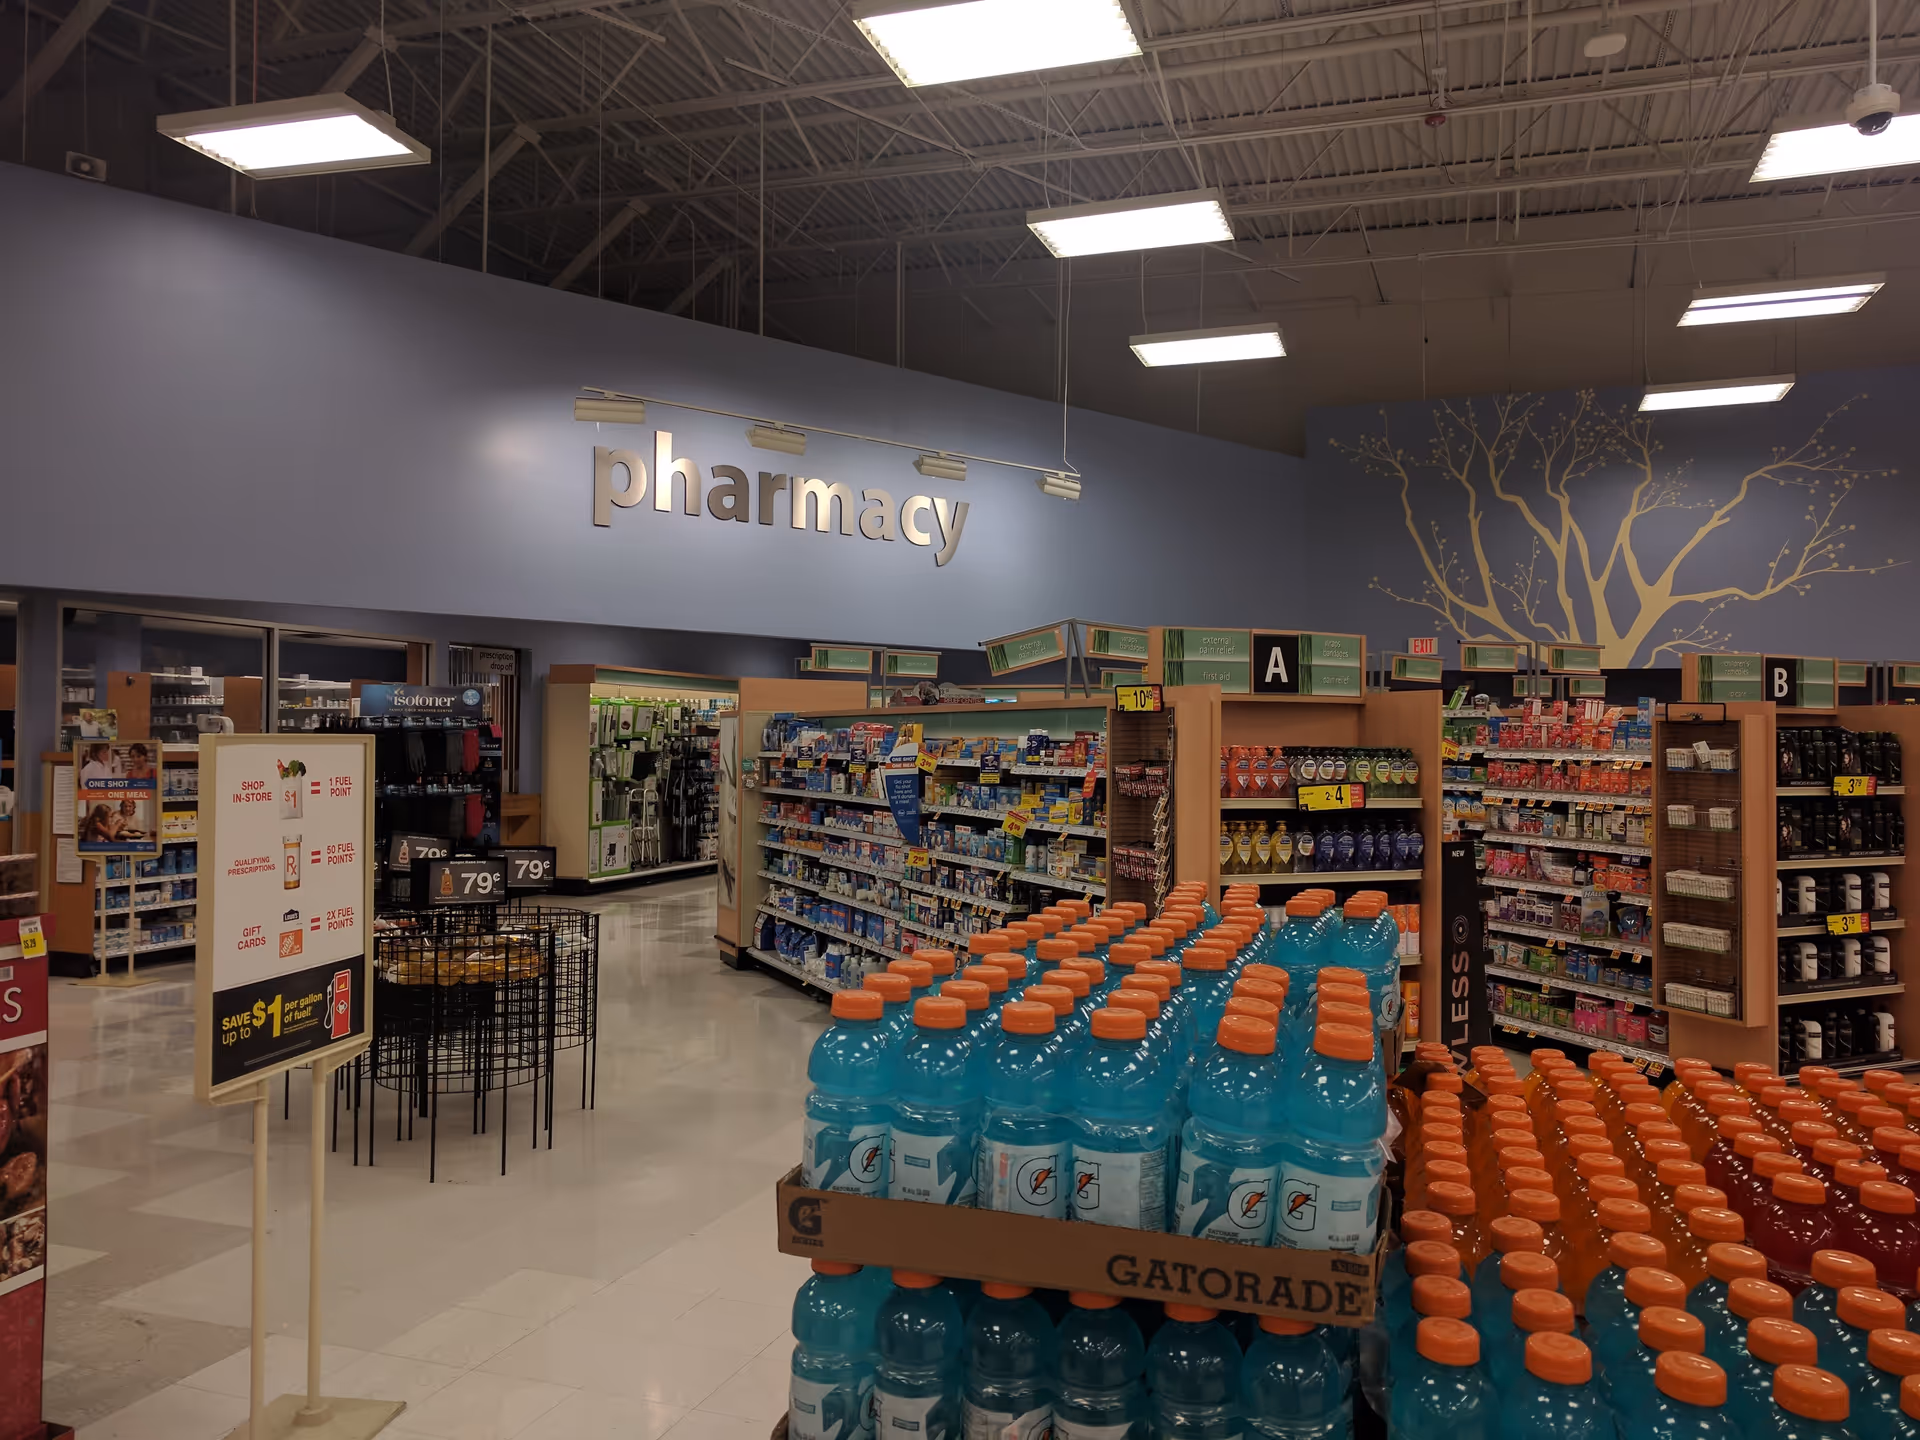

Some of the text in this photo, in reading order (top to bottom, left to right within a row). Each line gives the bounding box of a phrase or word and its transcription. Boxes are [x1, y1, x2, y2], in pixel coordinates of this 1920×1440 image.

[594, 431, 970, 567] pharmacy
[1202, 636, 1232, 645] external
[1413, 638, 1433, 653] EXIT
[479, 651, 514, 661] prescription
[1199, 645, 1235, 656] pain relief
[490, 662, 514, 672] drop off
[1264, 646, 1289, 683] A
[1203, 671, 1231, 681] first aid
[1773, 667, 1789, 698] B
[393, 691, 455, 707] isotoner
[88, 780, 106, 788] ONE
[107, 780, 129, 788] SHOT
[241, 781, 265, 791] SHOP
[329, 776, 353, 787] 1 FUEL
[108, 791, 125, 799] ONE
[126, 791, 149, 799] MEAL
[232, 791, 273, 803] IN-STORE
[330, 787, 352, 797] POINT
[284, 790, 297, 809] $1
[326, 842, 354, 854] 50 FUEL
[1452, 849, 1466, 858] NEW
[234, 856, 270, 867] QUALIFYING
[227, 863, 276, 877] PRESCRIPTIONS
[515, 859, 550, 880] 79¢
[461, 872, 501, 894] 79¢
[1583, 890, 1607, 898] HALLS
[326, 906, 355, 921] 2X FUEL
[327, 917, 354, 931] POINTS
[242, 925, 262, 938] GIFT
[237, 936, 267, 950] CARDS
[284, 992, 323, 1014] per gallon
[222, 1011, 251, 1031] SAVE
[252, 994, 283, 1038] $1
[283, 1010, 293, 1024] of
[222, 1026, 251, 1047] up to
[788, 1196, 823, 1237] G
[1207, 1227, 1240, 1237] GATORADE
[1106, 1254, 1364, 1317] GATORADE
